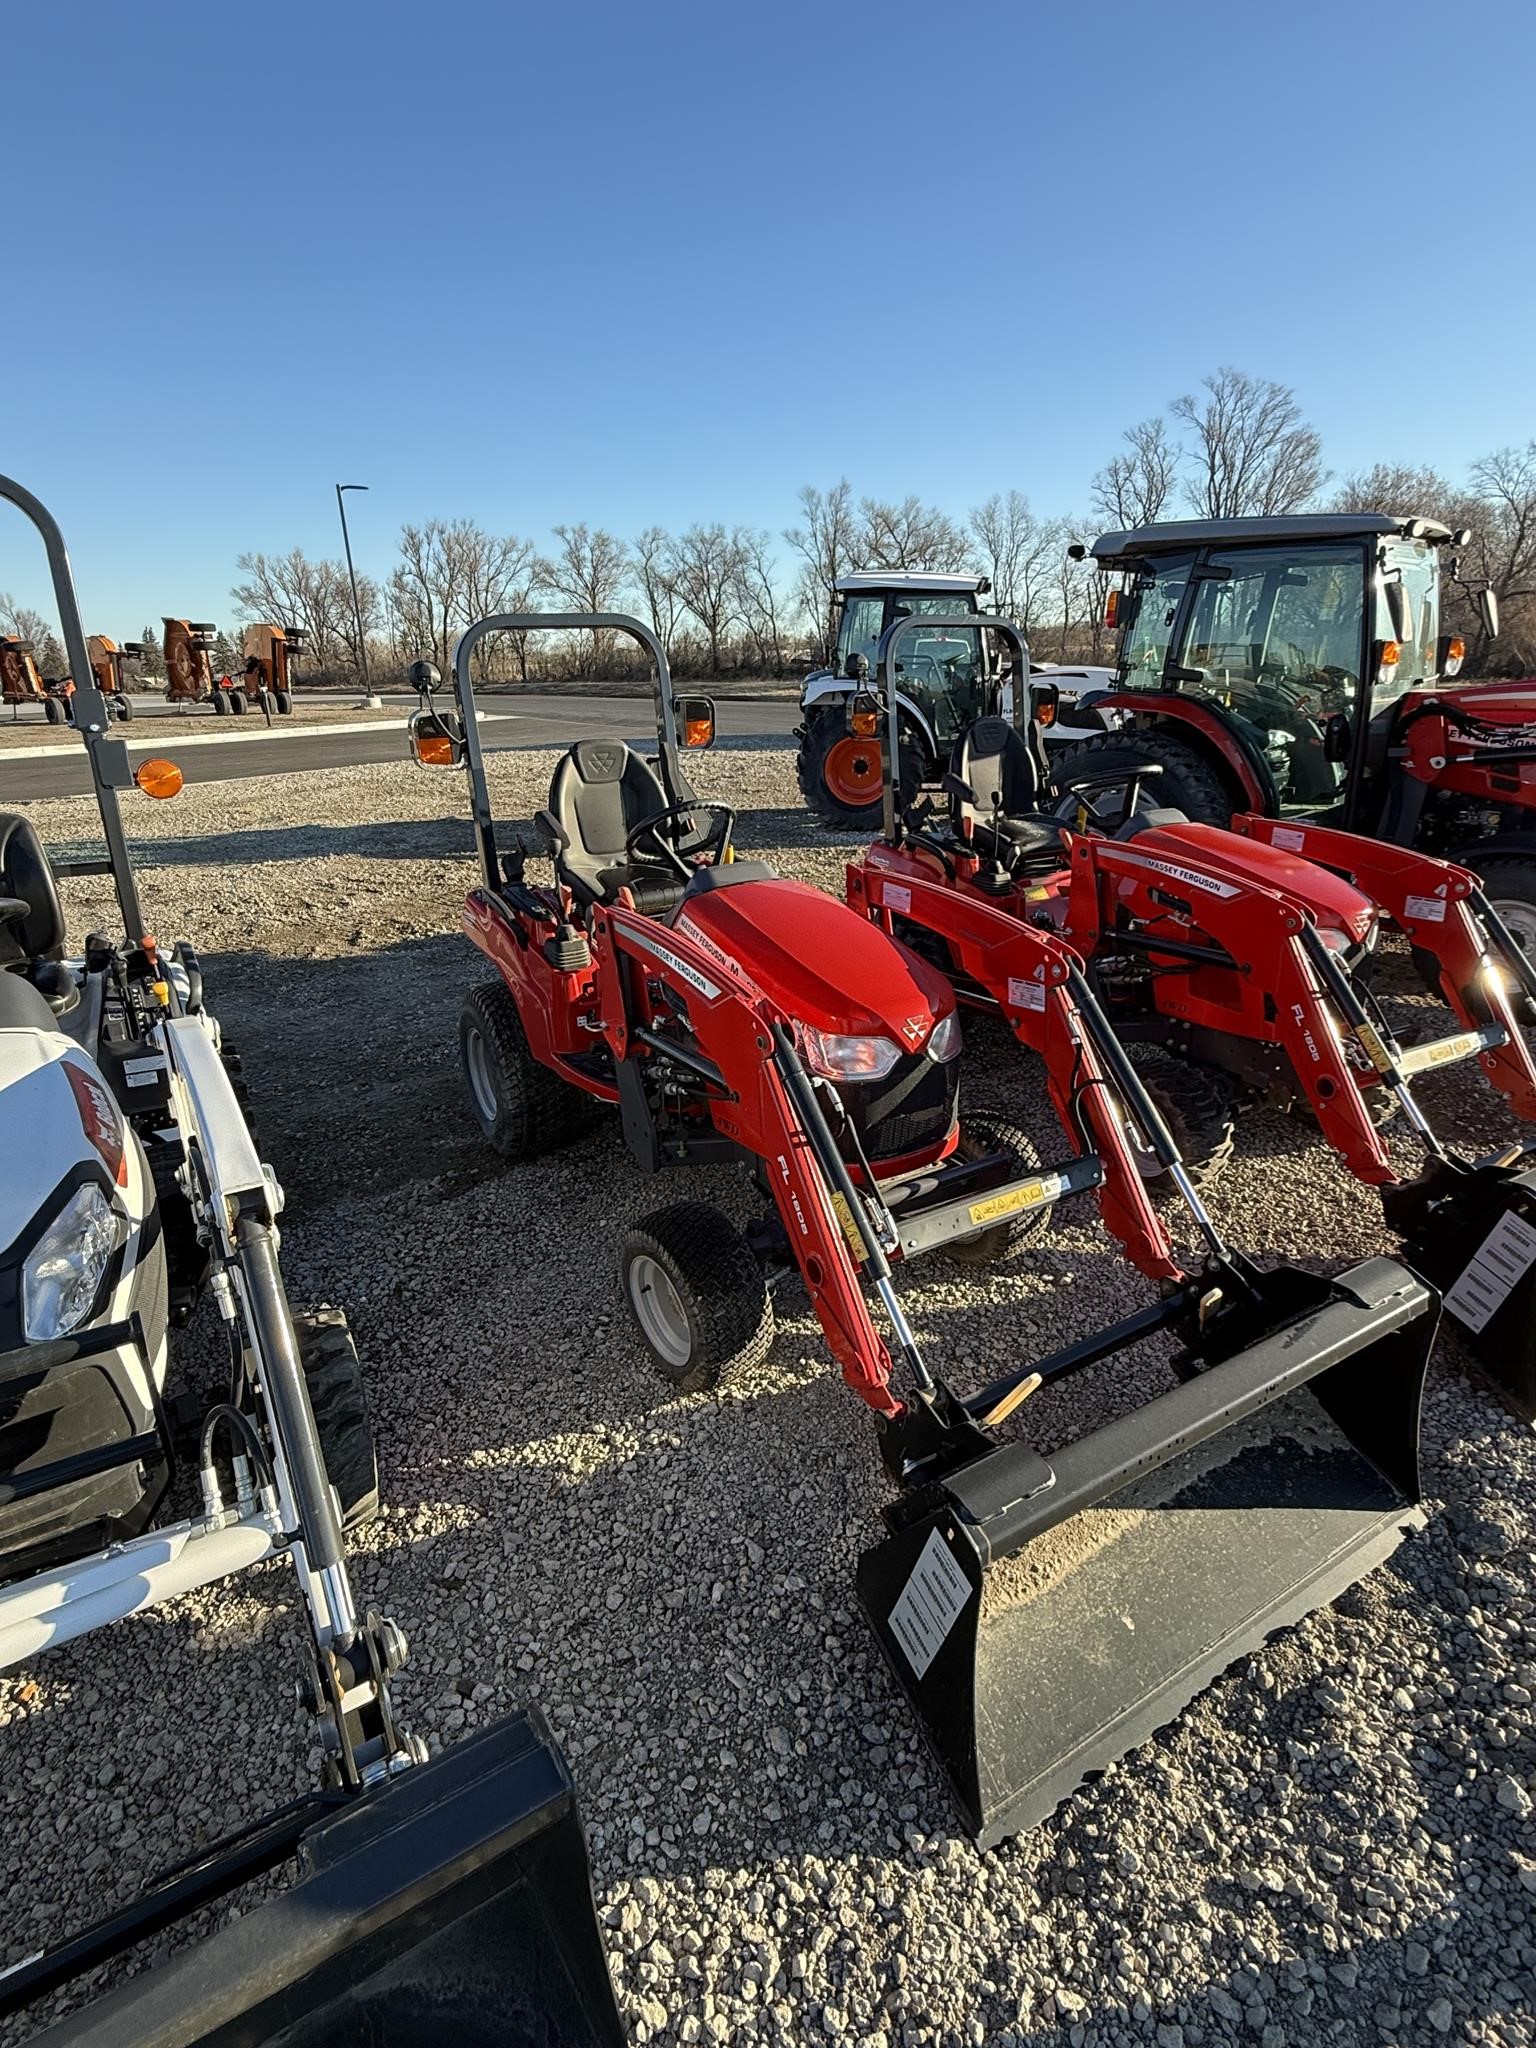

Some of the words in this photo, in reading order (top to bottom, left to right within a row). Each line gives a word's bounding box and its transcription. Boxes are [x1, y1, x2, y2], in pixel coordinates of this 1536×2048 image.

[1147, 860, 1178, 875] MASSEY
[1179, 870, 1221, 892] FERGUSON
[680, 919, 700, 940] MASSEY
[699, 936, 726, 965] FERGUSON
[650, 943, 673, 962] MASSEY
[674, 961, 706, 990] FERGUSON
[1291, 1003, 1305, 1027] FL
[1303, 1029, 1320, 1062] 1805
[777, 1155, 790, 1185] FL
